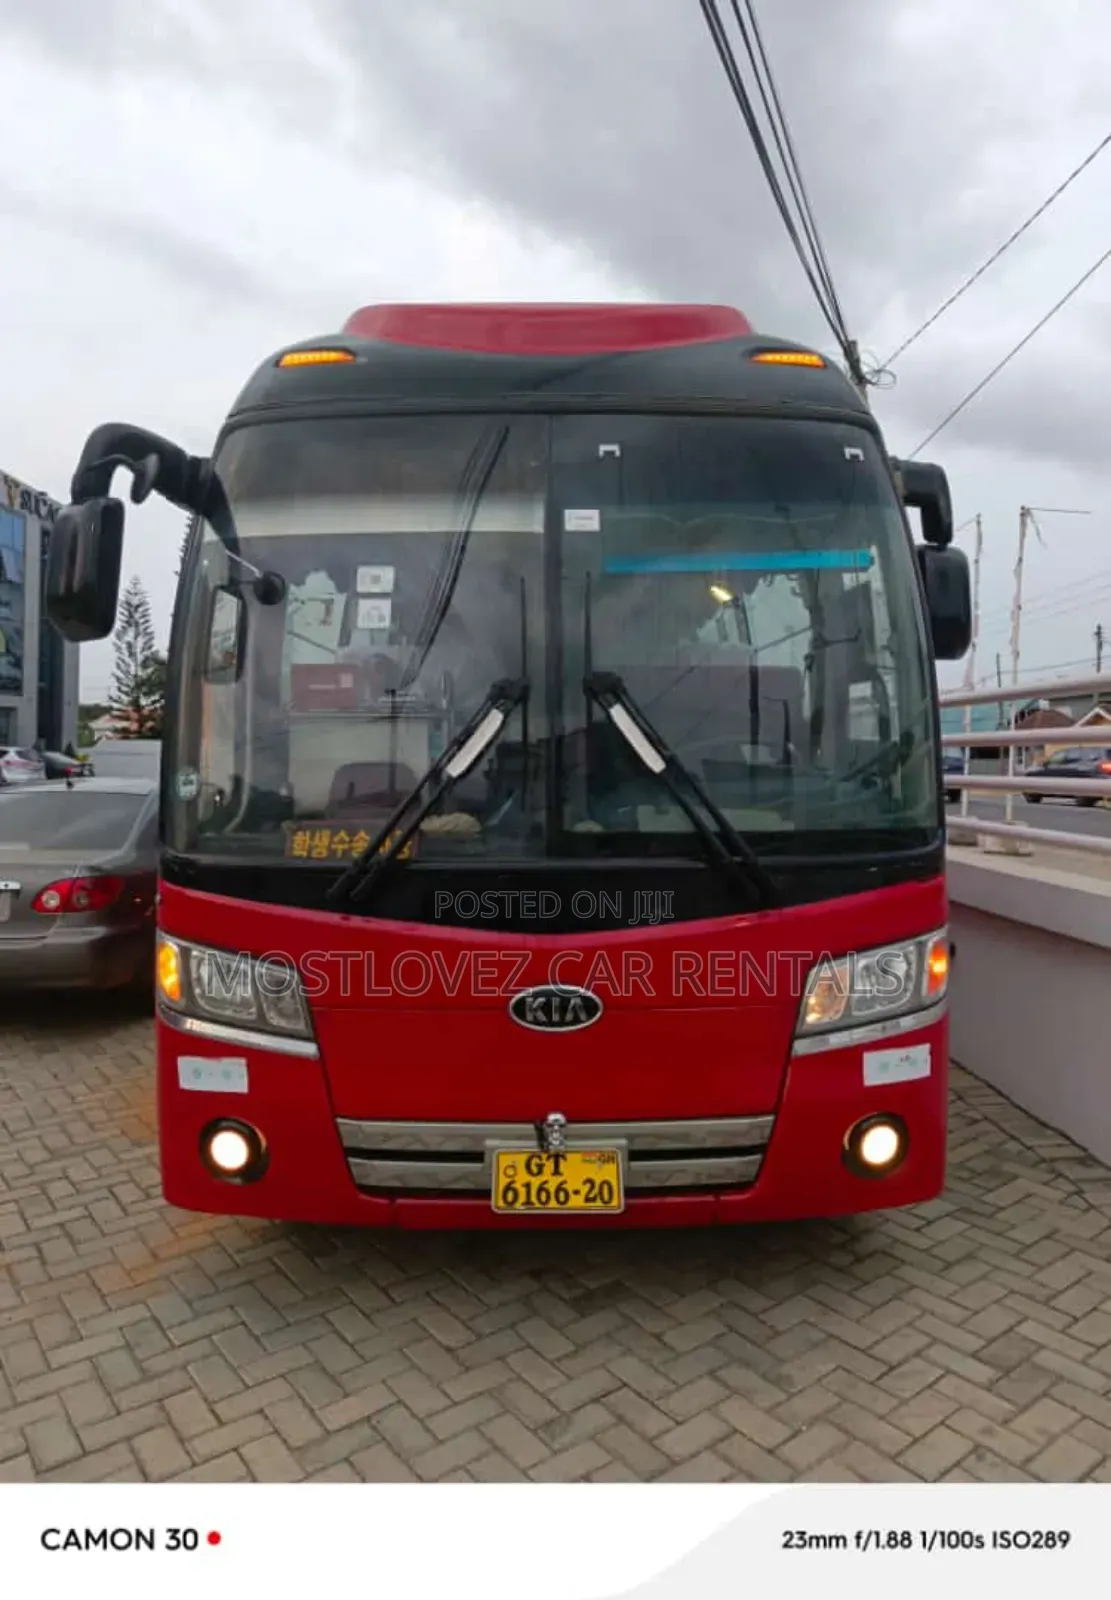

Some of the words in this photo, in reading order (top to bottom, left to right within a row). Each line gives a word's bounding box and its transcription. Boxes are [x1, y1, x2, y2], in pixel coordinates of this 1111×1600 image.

[525, 996, 588, 1022] KIA
[525, 1153, 567, 1177] GT
[502, 1178, 614, 1206] 6166-20
